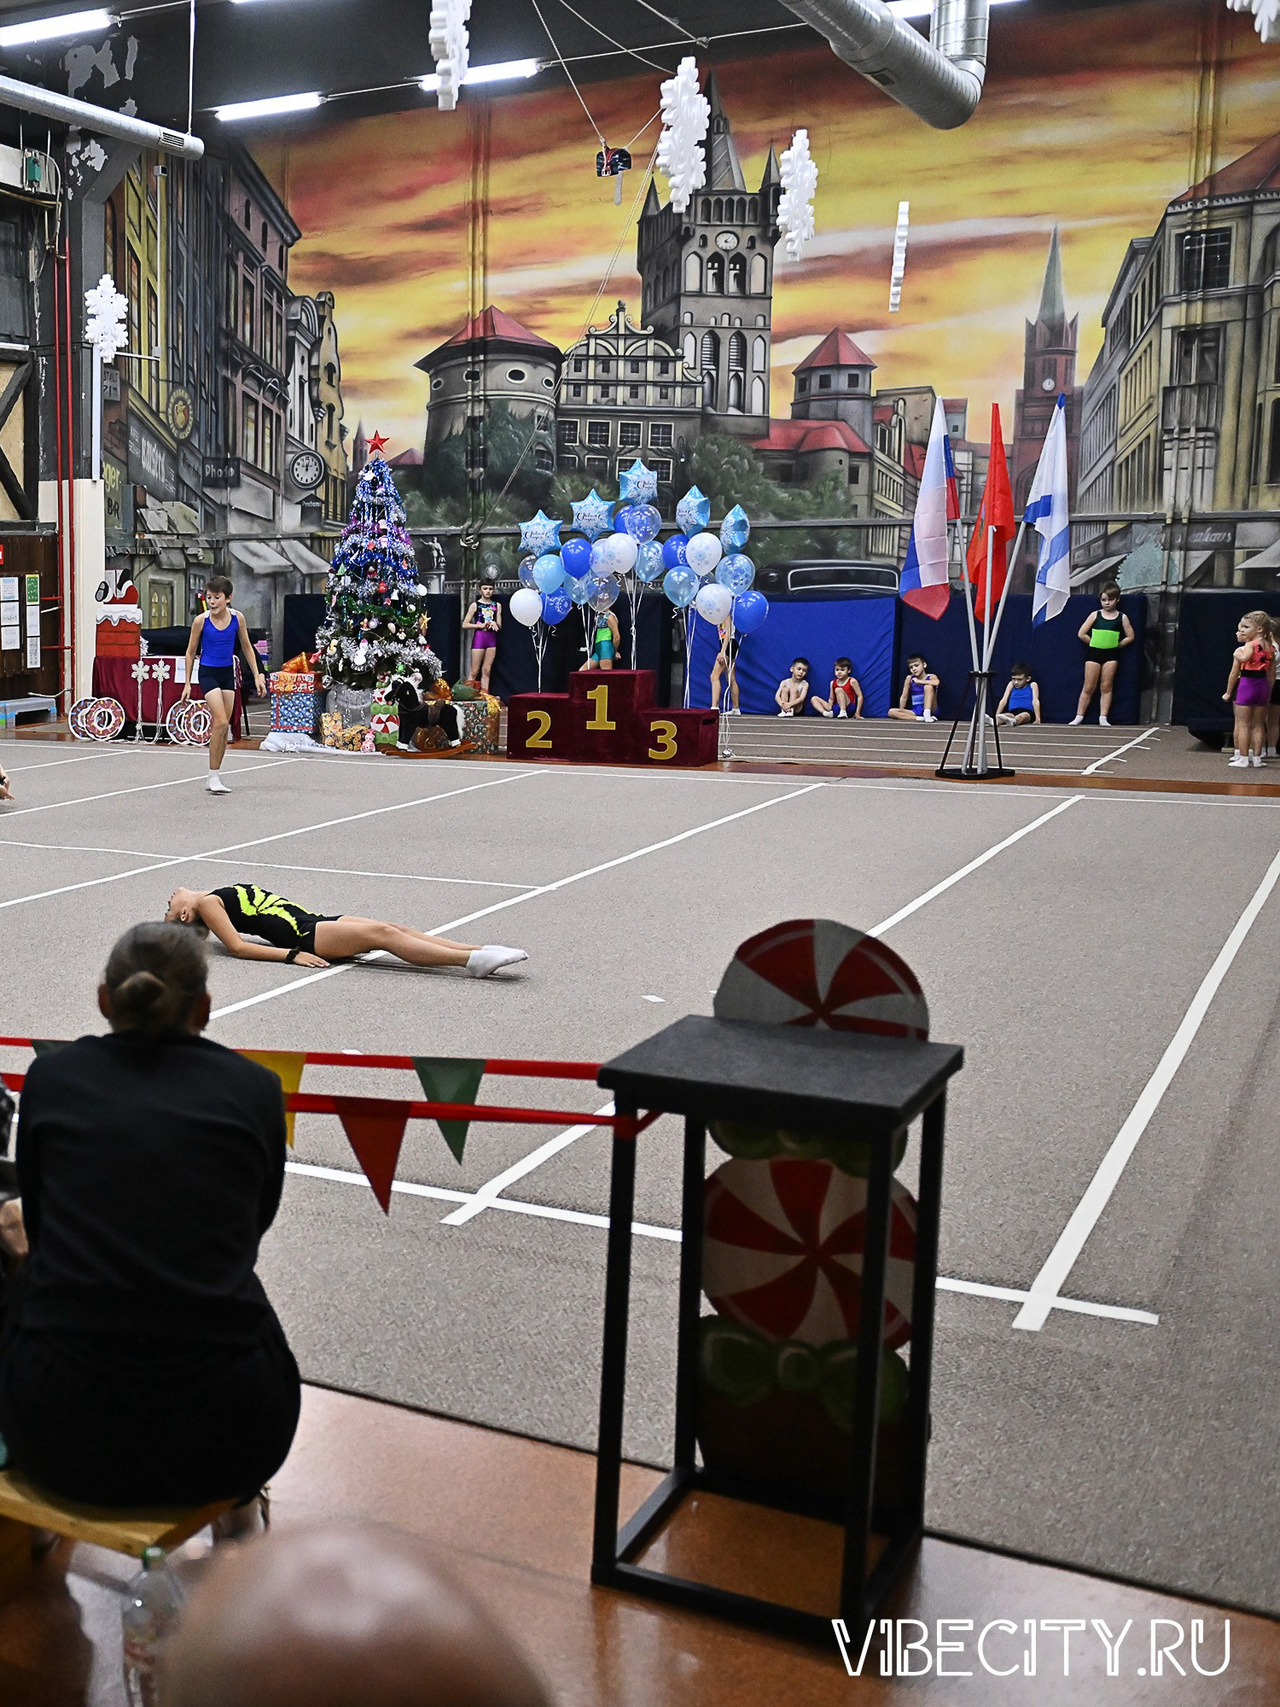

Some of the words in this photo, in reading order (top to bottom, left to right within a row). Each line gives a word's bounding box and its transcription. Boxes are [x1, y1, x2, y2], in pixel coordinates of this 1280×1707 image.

[585, 684, 617, 731] 1
[525, 710, 553, 749] 2
[648, 720, 678, 760] 3
